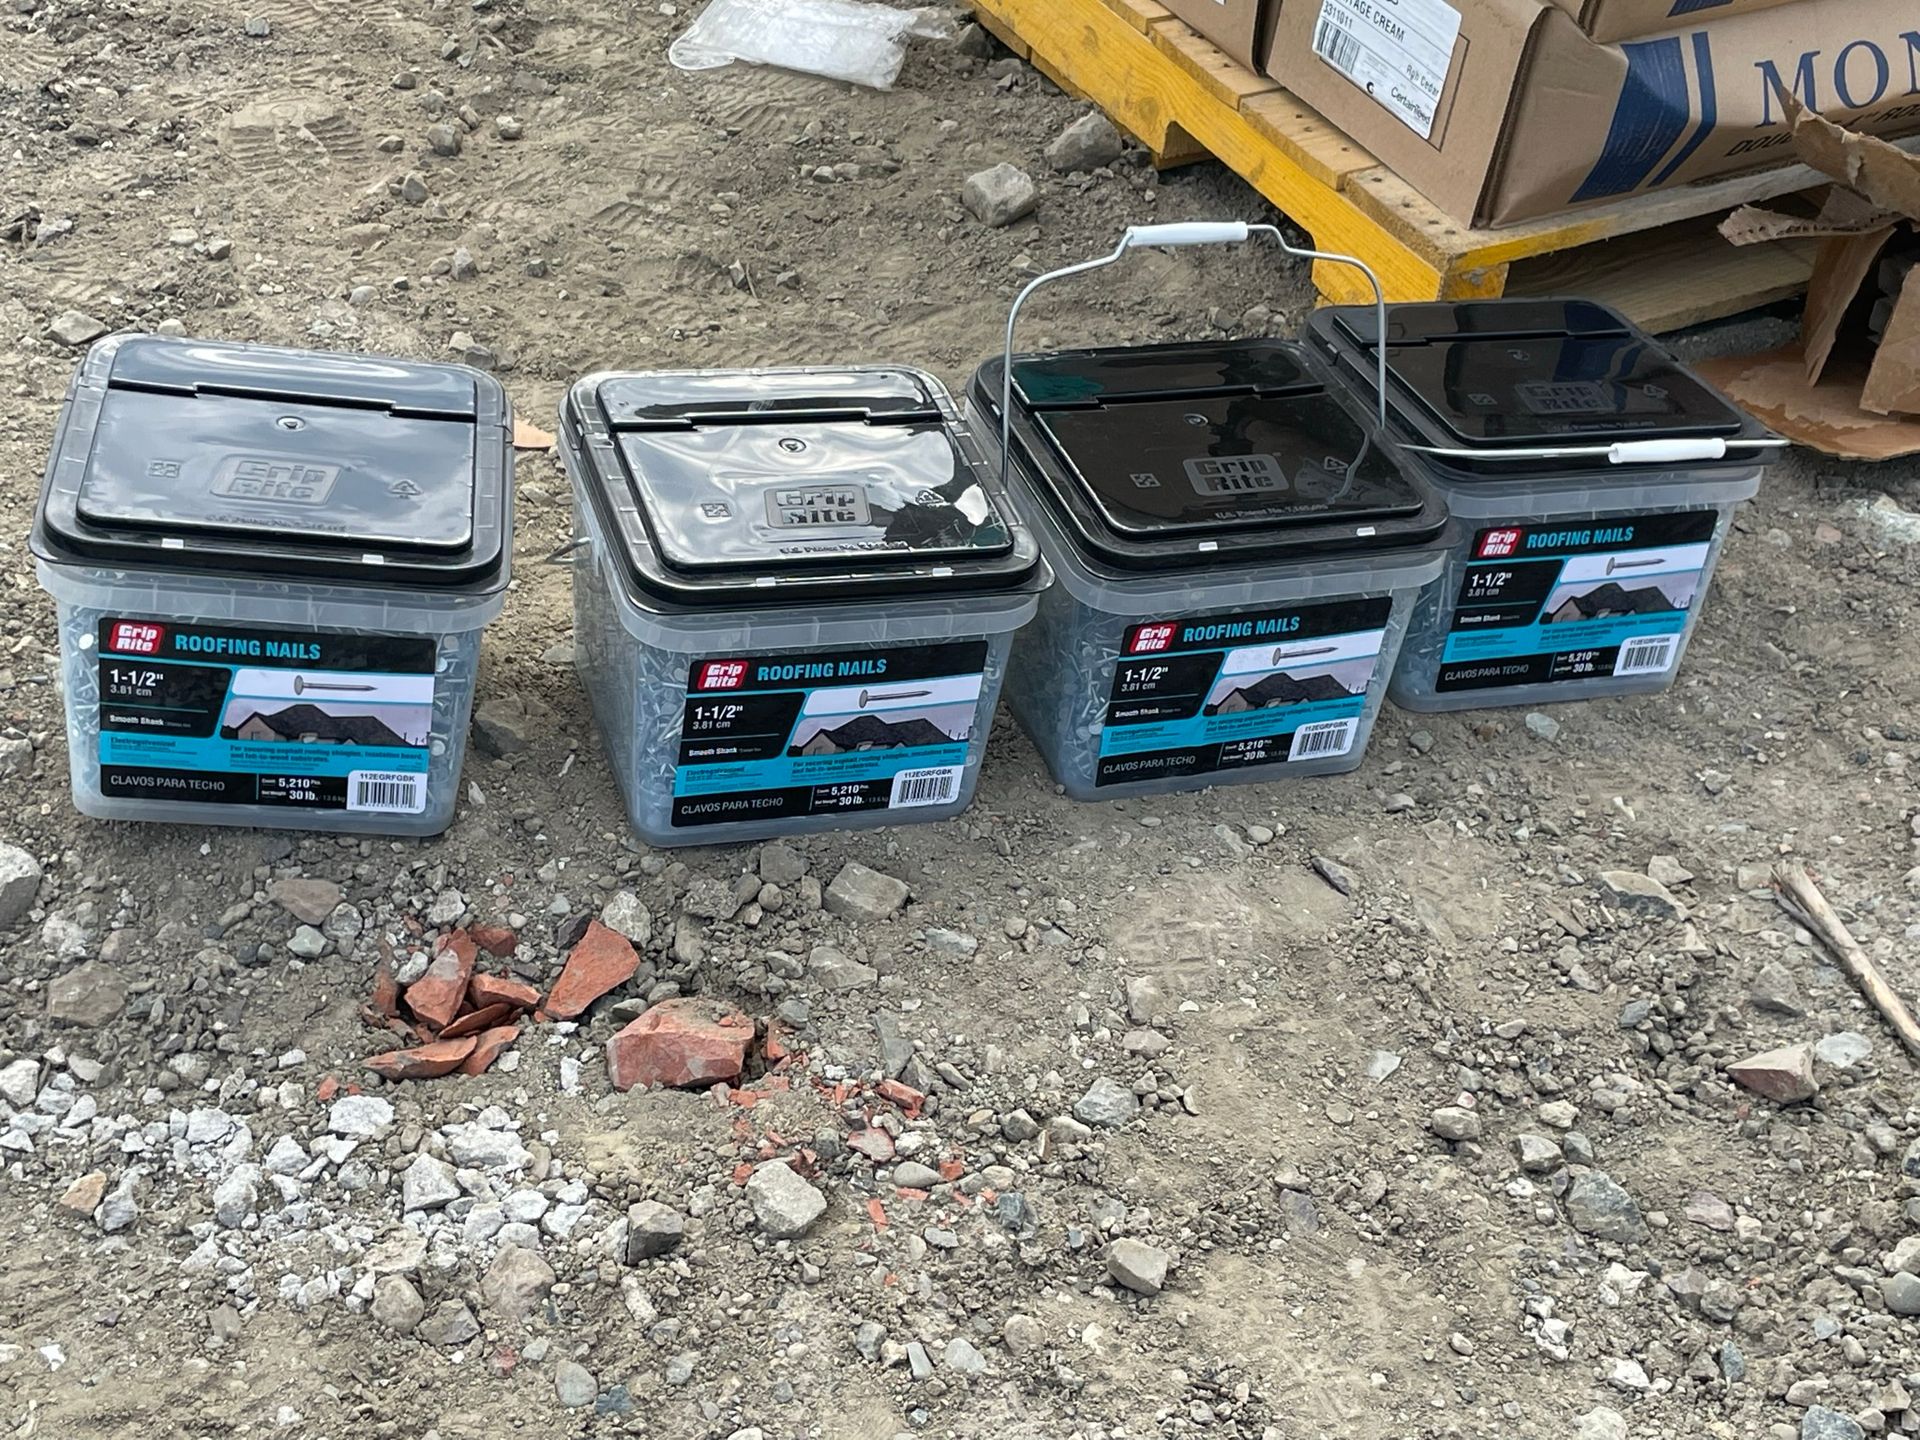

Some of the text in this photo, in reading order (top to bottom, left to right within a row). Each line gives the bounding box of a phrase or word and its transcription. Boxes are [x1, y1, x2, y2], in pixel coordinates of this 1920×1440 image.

[1323, 4, 1352, 29] 3311011
[1373, 10, 1405, 42] CREAM
[1391, 86, 1431, 125] CertainTeed
[234, 460, 327, 484] Grip
[1195, 460, 1267, 475] Grip
[227, 477, 315, 498] Rite
[1203, 475, 1275, 490] Rite
[776, 488, 855, 507] Grip
[1487, 532, 1516, 544] Grip
[1526, 527, 1634, 549] ROOFING NAILS
[1483, 544, 1512, 555] Rite
[1471, 572, 1512, 587] 1-1/2"
[1486, 588, 1499, 596] cm
[118, 624, 157, 641] Grip
[1139, 626, 1171, 641] Grip
[1183, 616, 1300, 642] ROOFING NAILS
[116, 638, 153, 652] Rite
[175, 634, 321, 660] ROOFING NAILS
[1135, 638, 1165, 652] Rite
[1568, 651, 1592, 662] 5,210
[707, 663, 743, 678] Grip
[757, 659, 887, 681] ROOFING NAILS
[1125, 667, 1169, 682] 1-1/2"
[1445, 664, 1529, 681] CLAVOS PARA TECHO
[1573, 664, 1585, 673] 30
[110, 669, 163, 687] 1-1/2"
[704, 675, 738, 688] Rite
[110, 685, 152, 697] 3.81 cm
[1142, 682, 1156, 690] cm
[695, 704, 743, 719] 1-1/2"
[692, 720, 731, 731] 3.81 cm
[1238, 740, 1264, 751] 5,210
[1244, 751, 1256, 761] 30
[1103, 755, 1196, 774] CLAVOS PARA TECHO
[111, 774, 225, 792] CLAVOS PARA TECHO
[278, 777, 310, 789] 5,210
[831, 784, 859, 796] 5,210
[289, 789, 303, 800] 30
[305, 790, 319, 801] lb.
[838, 796, 852, 806] 30
[852, 795, 865, 805] lb.
[681, 797, 784, 815] CLAVOS PARA TECHO
